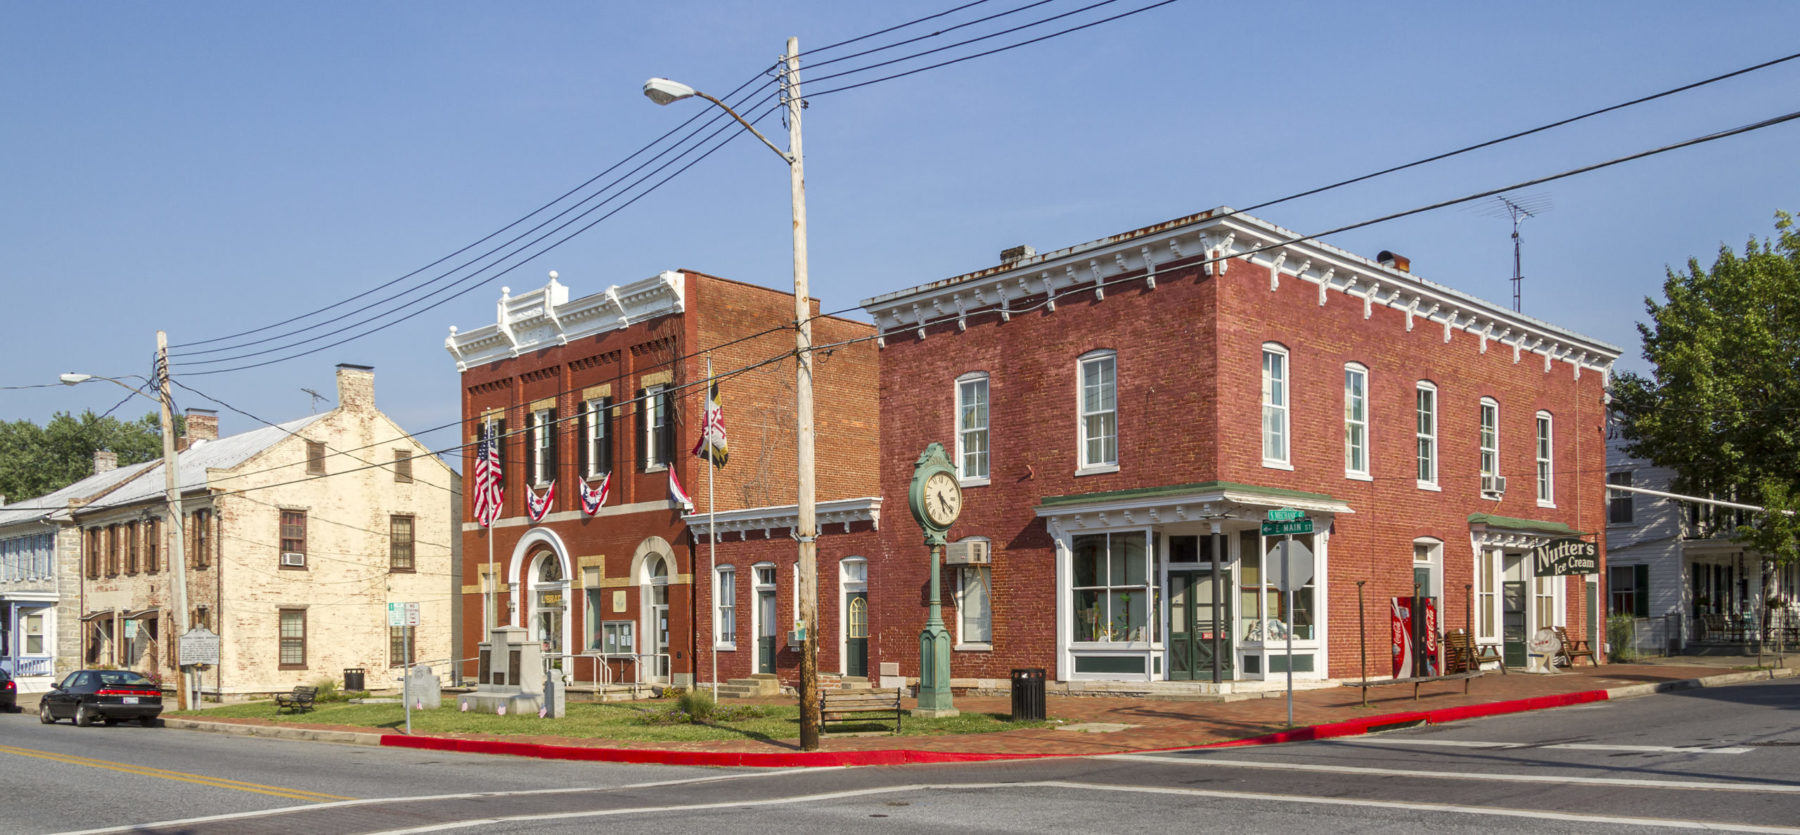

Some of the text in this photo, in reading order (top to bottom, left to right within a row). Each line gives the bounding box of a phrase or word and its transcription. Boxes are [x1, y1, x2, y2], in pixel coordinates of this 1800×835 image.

[1276, 524, 1280, 532] E
[1283, 523, 1302, 531] MAIN
[1537, 540, 1594, 572] Nutter's
[1554, 556, 1594, 575] Ice Cream
